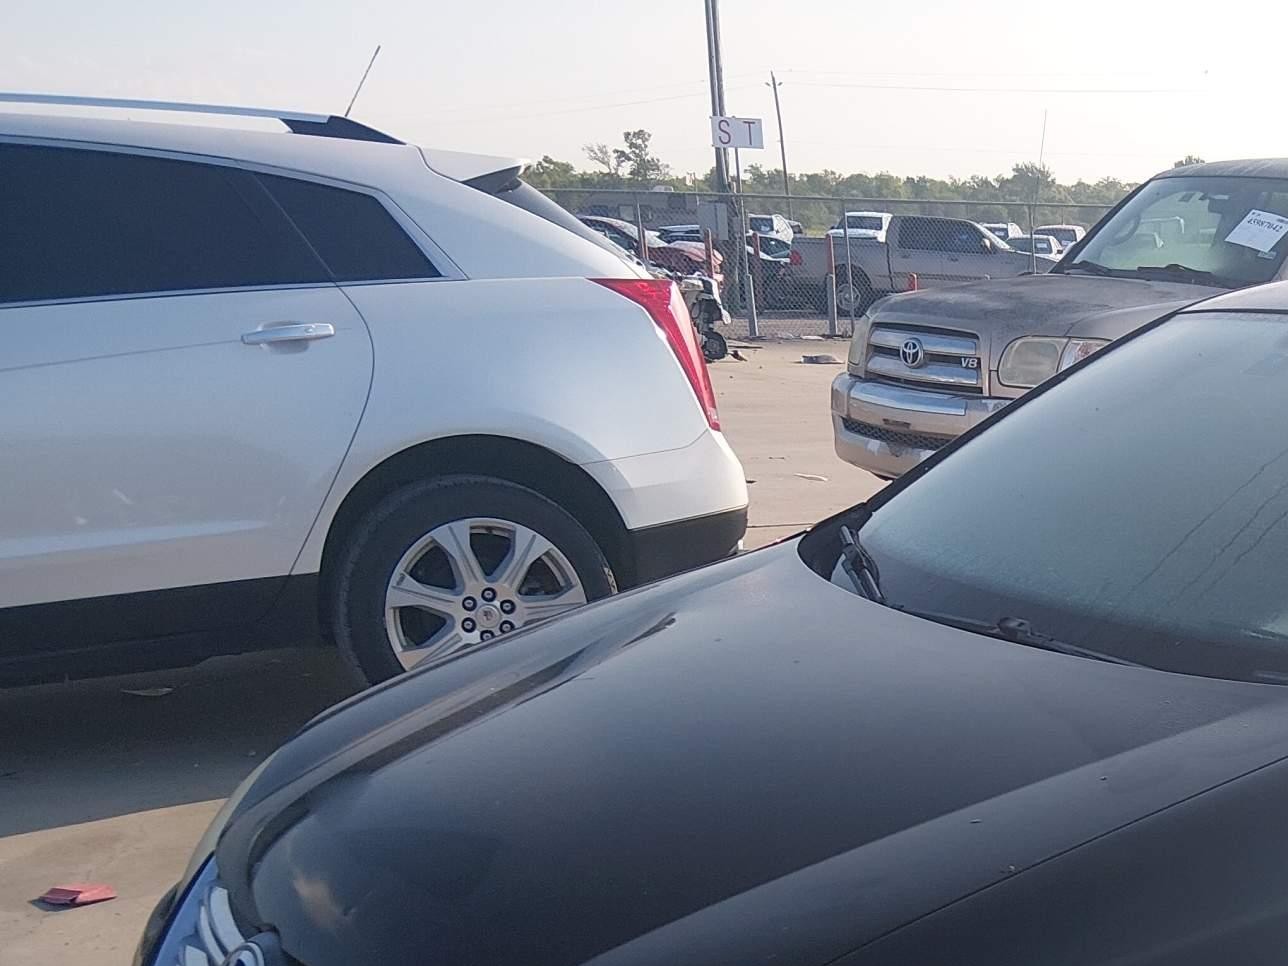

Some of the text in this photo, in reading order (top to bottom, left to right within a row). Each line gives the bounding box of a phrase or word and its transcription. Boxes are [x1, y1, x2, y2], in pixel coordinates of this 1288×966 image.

[718, 119, 756, 146] S T
[961, 357, 978, 369] V8
